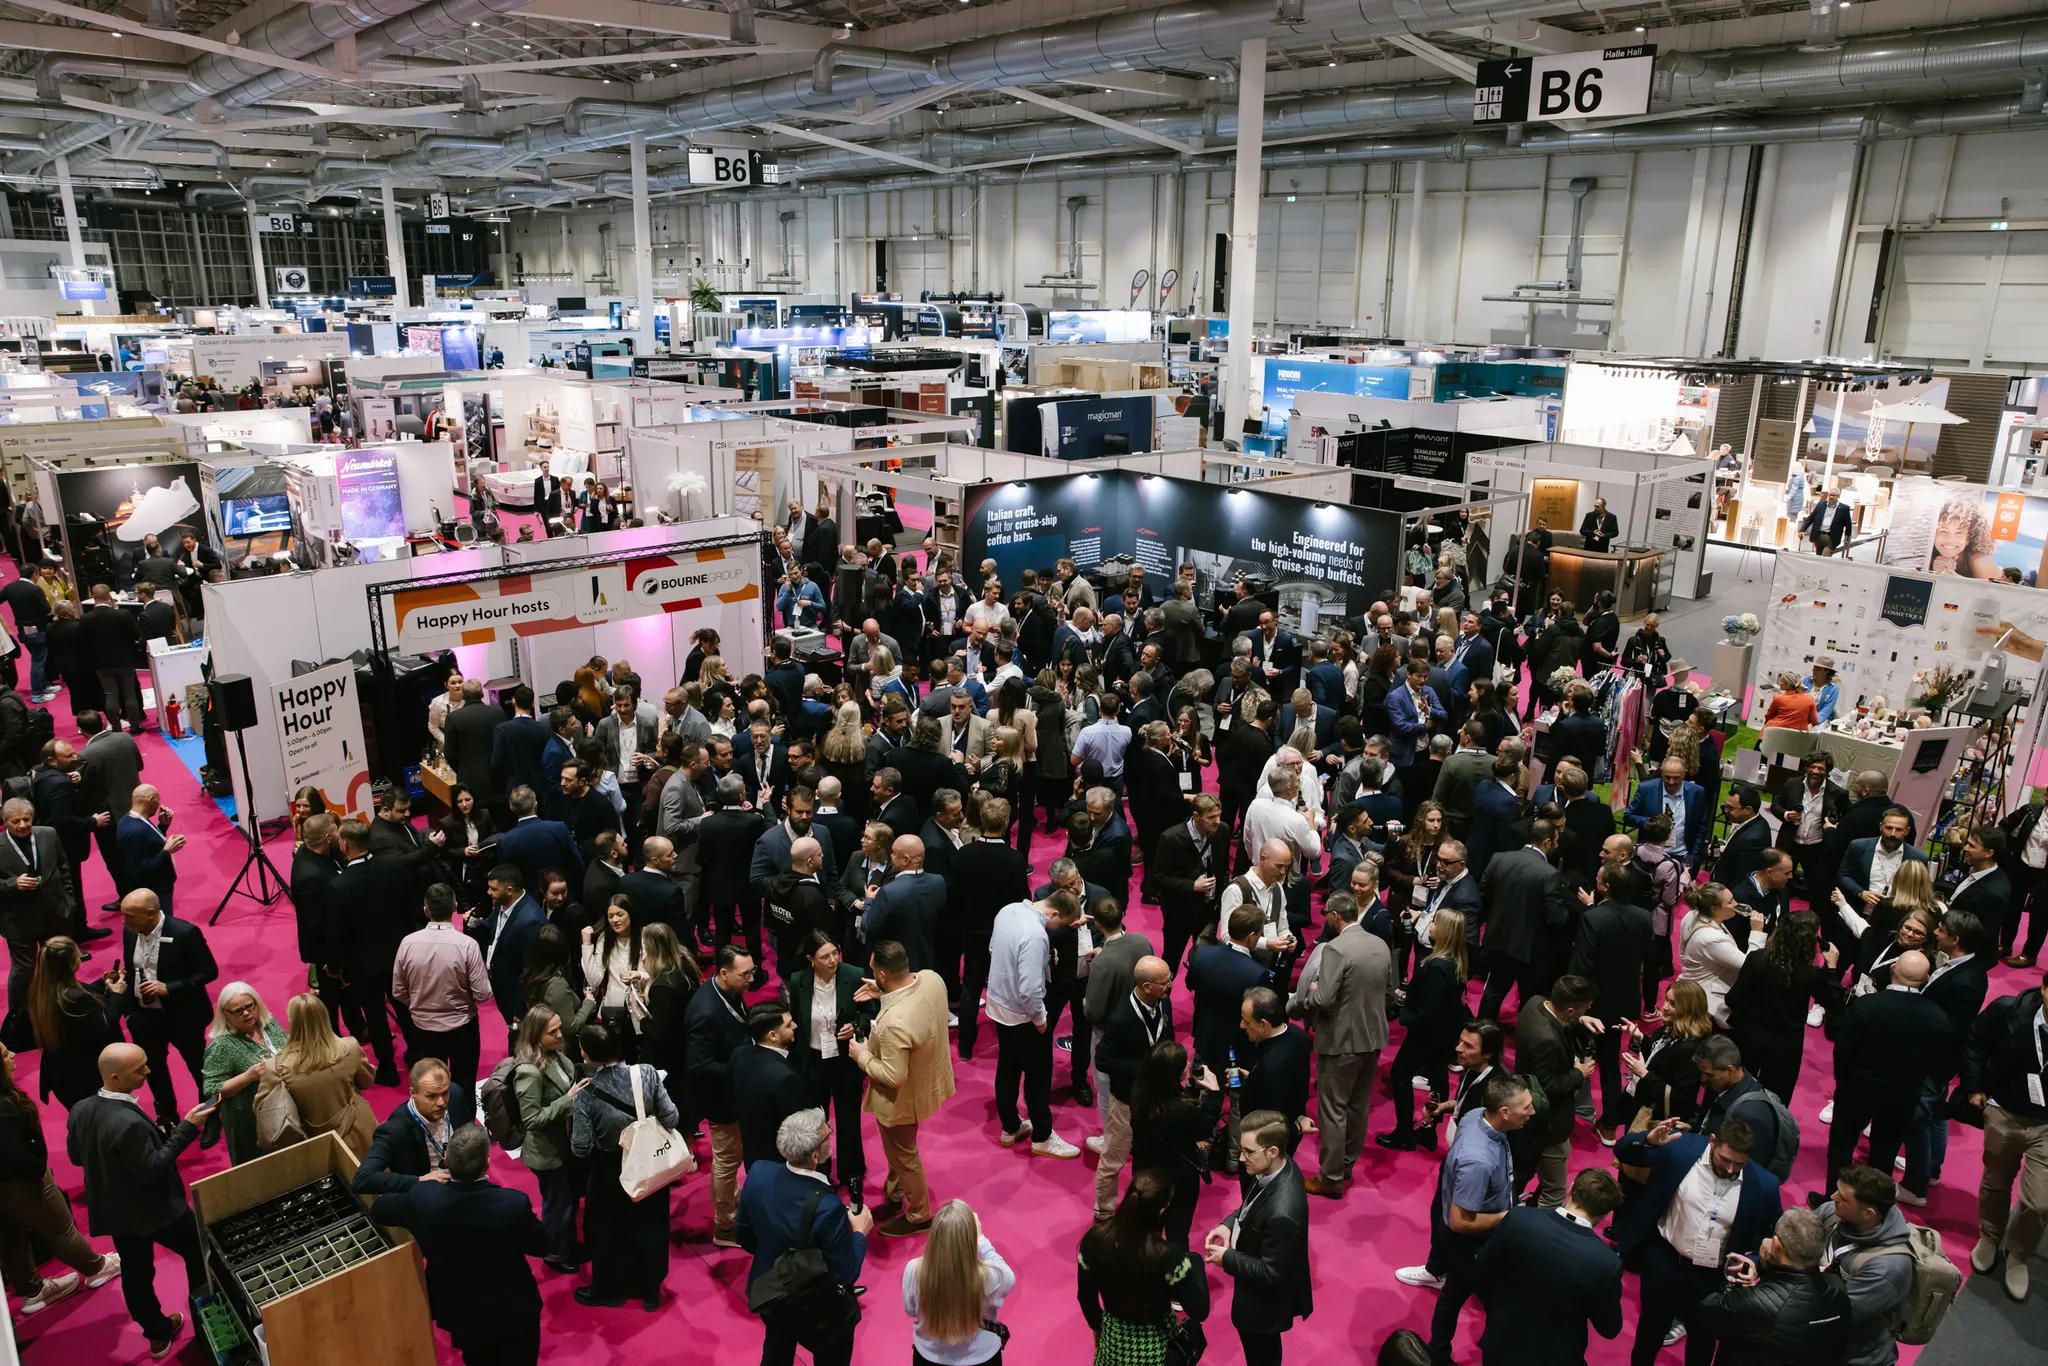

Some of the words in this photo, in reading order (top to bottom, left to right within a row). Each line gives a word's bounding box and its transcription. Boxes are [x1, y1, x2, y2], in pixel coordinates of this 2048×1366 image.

[1605, 50, 1625, 59] Halle
[1627, 48, 1643, 57] Hall
[1539, 67, 1604, 116] B6
[714, 156, 747, 182] B6
[433, 199, 443, 217] B6
[270, 217, 292, 231] B6
[229, 338, 266, 346] possibilities
[270, 337, 295, 345] straight
[322, 335, 344, 343] factory
[1087, 410, 1121, 422] magicman
[857, 429, 867, 437] CSI
[1414, 433, 1449, 443] AIRMONT
[4, 438, 20, 446] CSI
[715, 442, 727, 450] CSI
[1413, 448, 1437, 457] SEAMLESS
[1437, 450, 1449, 458] IPTV
[1418, 455, 1445, 464] STREAMING
[1470, 456, 1483, 465] CSI
[836, 467, 856, 477] International
[341, 486, 360, 494] MADE
[368, 483, 397, 493] GERMANY
[987, 508, 1013, 522] Italian
[1014, 505, 1037, 519] craft,
[987, 521, 1003, 534] built
[1003, 520, 1014, 532] for
[1015, 514, 1057, 530] cruise-ship
[986, 533, 1012, 546] coffee
[1013, 530, 1032, 543] bars.
[1292, 531, 1347, 553] Engineered
[1349, 542, 1365, 557] for
[1251, 537, 1266, 551] the
[1268, 540, 1327, 565] high-volume
[1328, 551, 1353, 569] needs
[1354, 557, 1365, 572] of
[1272, 557, 1325, 579] cruise-ship
[1326, 565, 1365, 587] buffets.
[582, 606, 619, 617] HARMONY
[1885, 602, 1924, 614] SAUVAGE
[416, 611, 468, 630] Happy
[472, 604, 508, 622] Hour
[511, 600, 550, 617] hosts
[278, 676, 347, 713] Happy
[283, 705, 333, 736] Hour
[287, 735, 309, 747] 5.00pm
[311, 726, 332, 738] 6.00pm
[288, 747, 304, 757] Open
